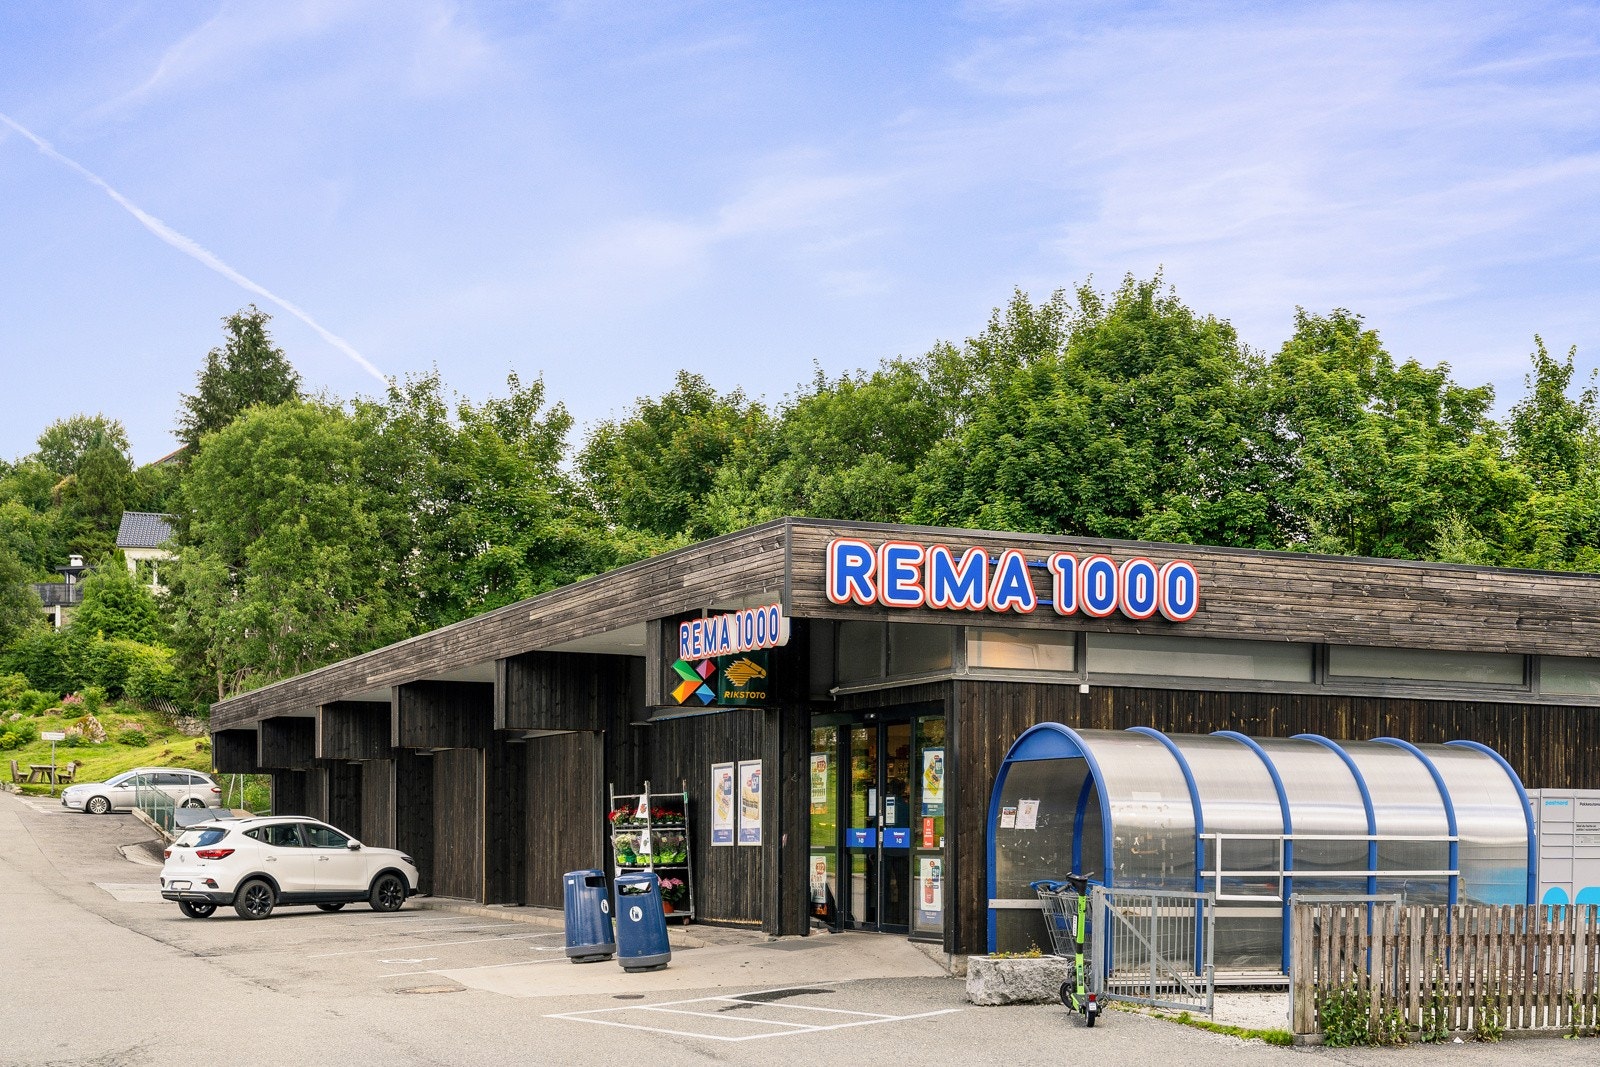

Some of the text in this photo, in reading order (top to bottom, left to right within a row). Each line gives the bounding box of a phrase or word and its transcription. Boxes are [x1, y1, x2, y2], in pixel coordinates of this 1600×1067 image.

[827, 538, 1199, 622] REMA 1000
[681, 604, 779, 659] REMA 1000
[723, 690, 766, 699] RIKSTOTO
